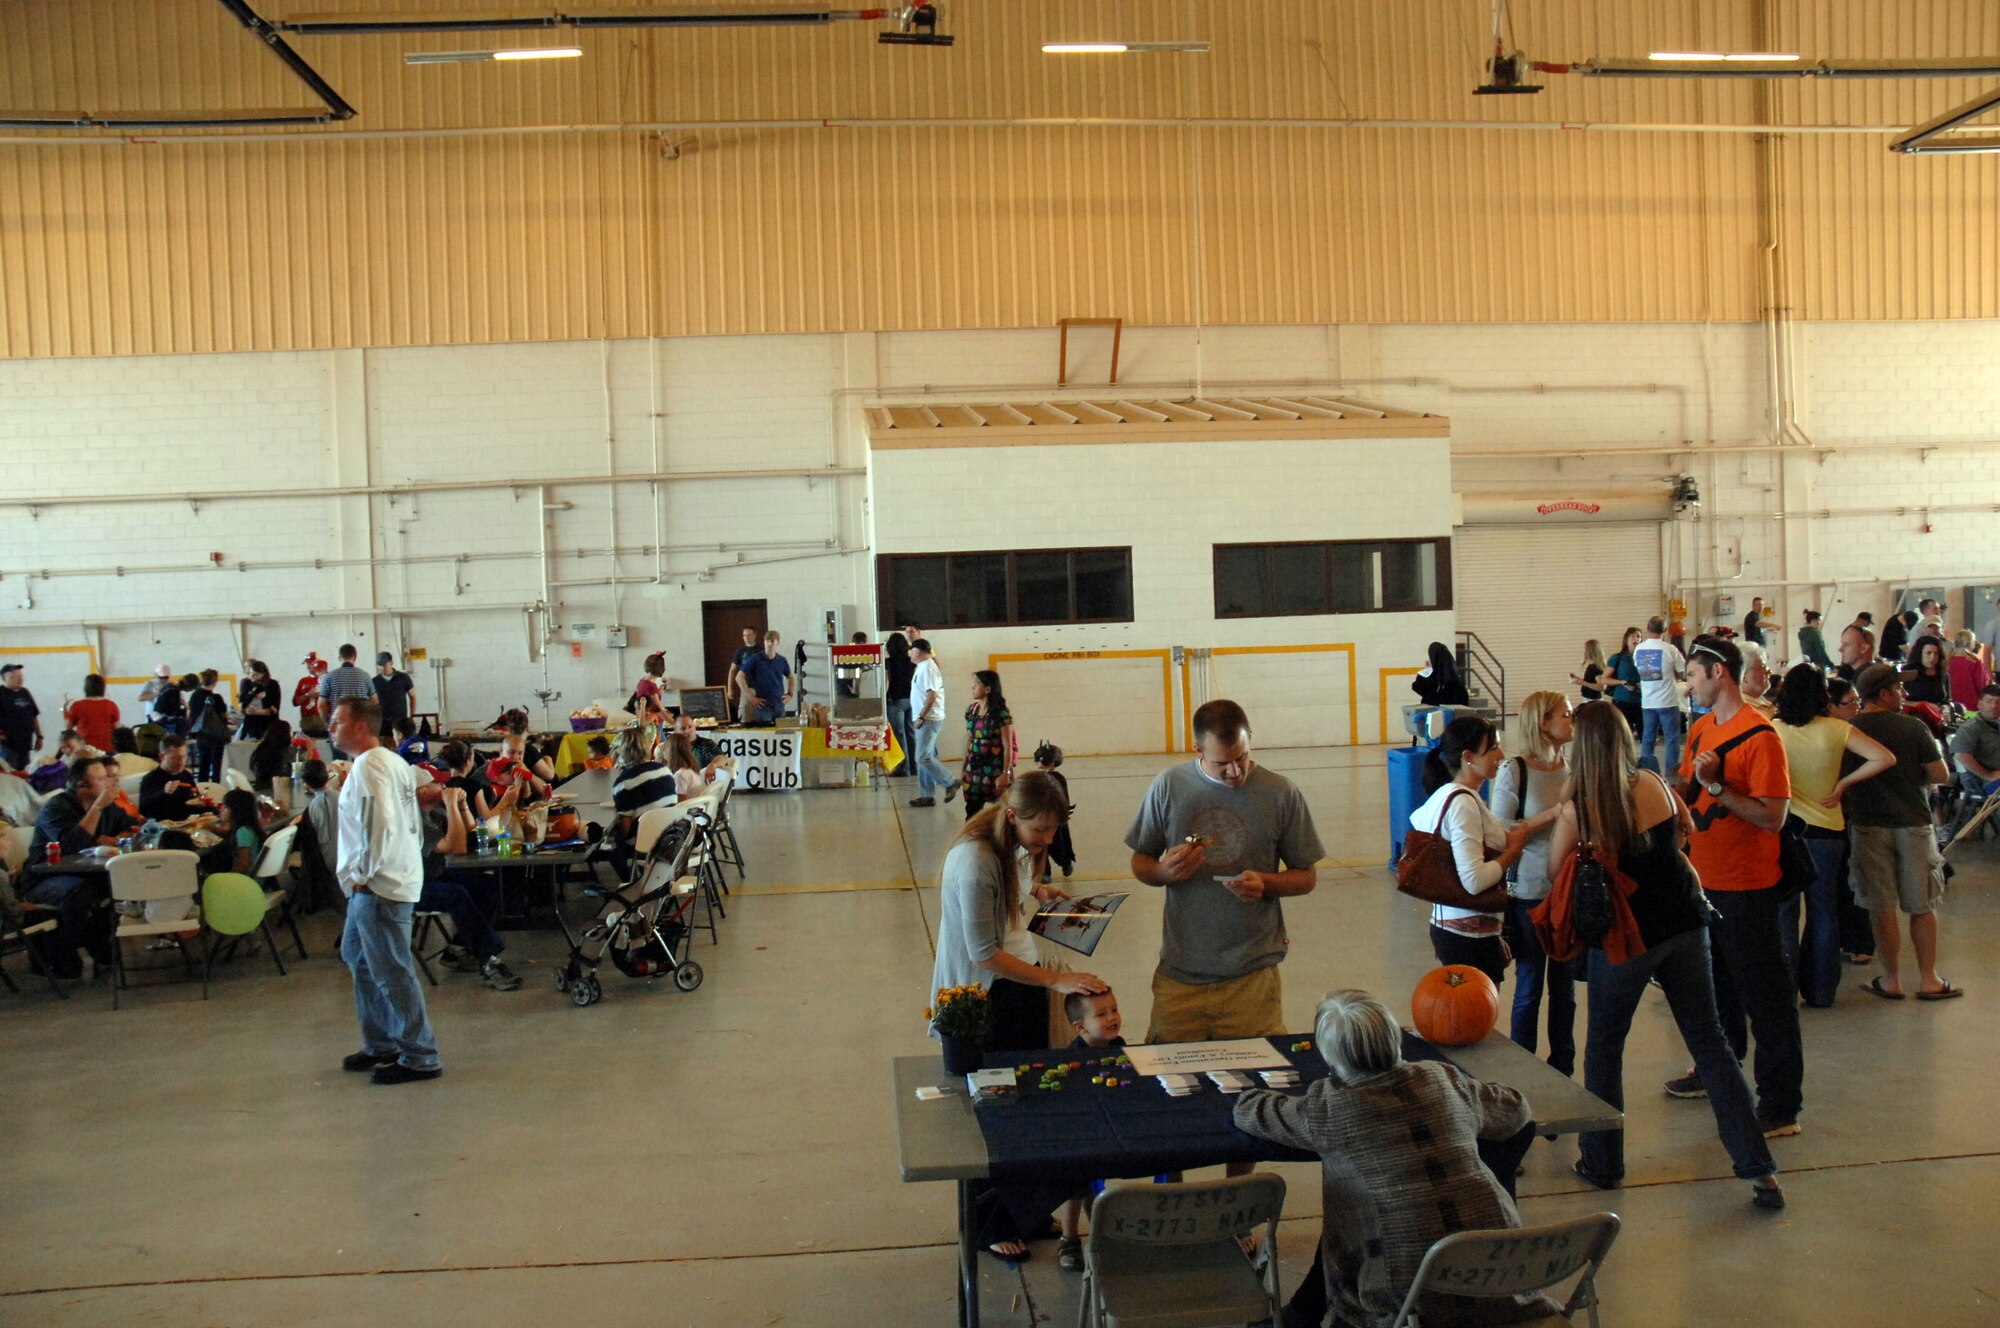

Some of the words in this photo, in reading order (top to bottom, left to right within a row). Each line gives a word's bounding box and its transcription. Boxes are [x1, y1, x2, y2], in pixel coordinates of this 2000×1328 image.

[1044, 652, 1069, 660] ENGINE
[1087, 650, 1100, 658] BOX
[719, 738, 792, 757] gasus
[746, 766, 797, 788] Club
[1156, 1192, 1185, 1212] 27
[1115, 1216, 1197, 1237] X-2773
[1488, 1238, 1521, 1261] 27
